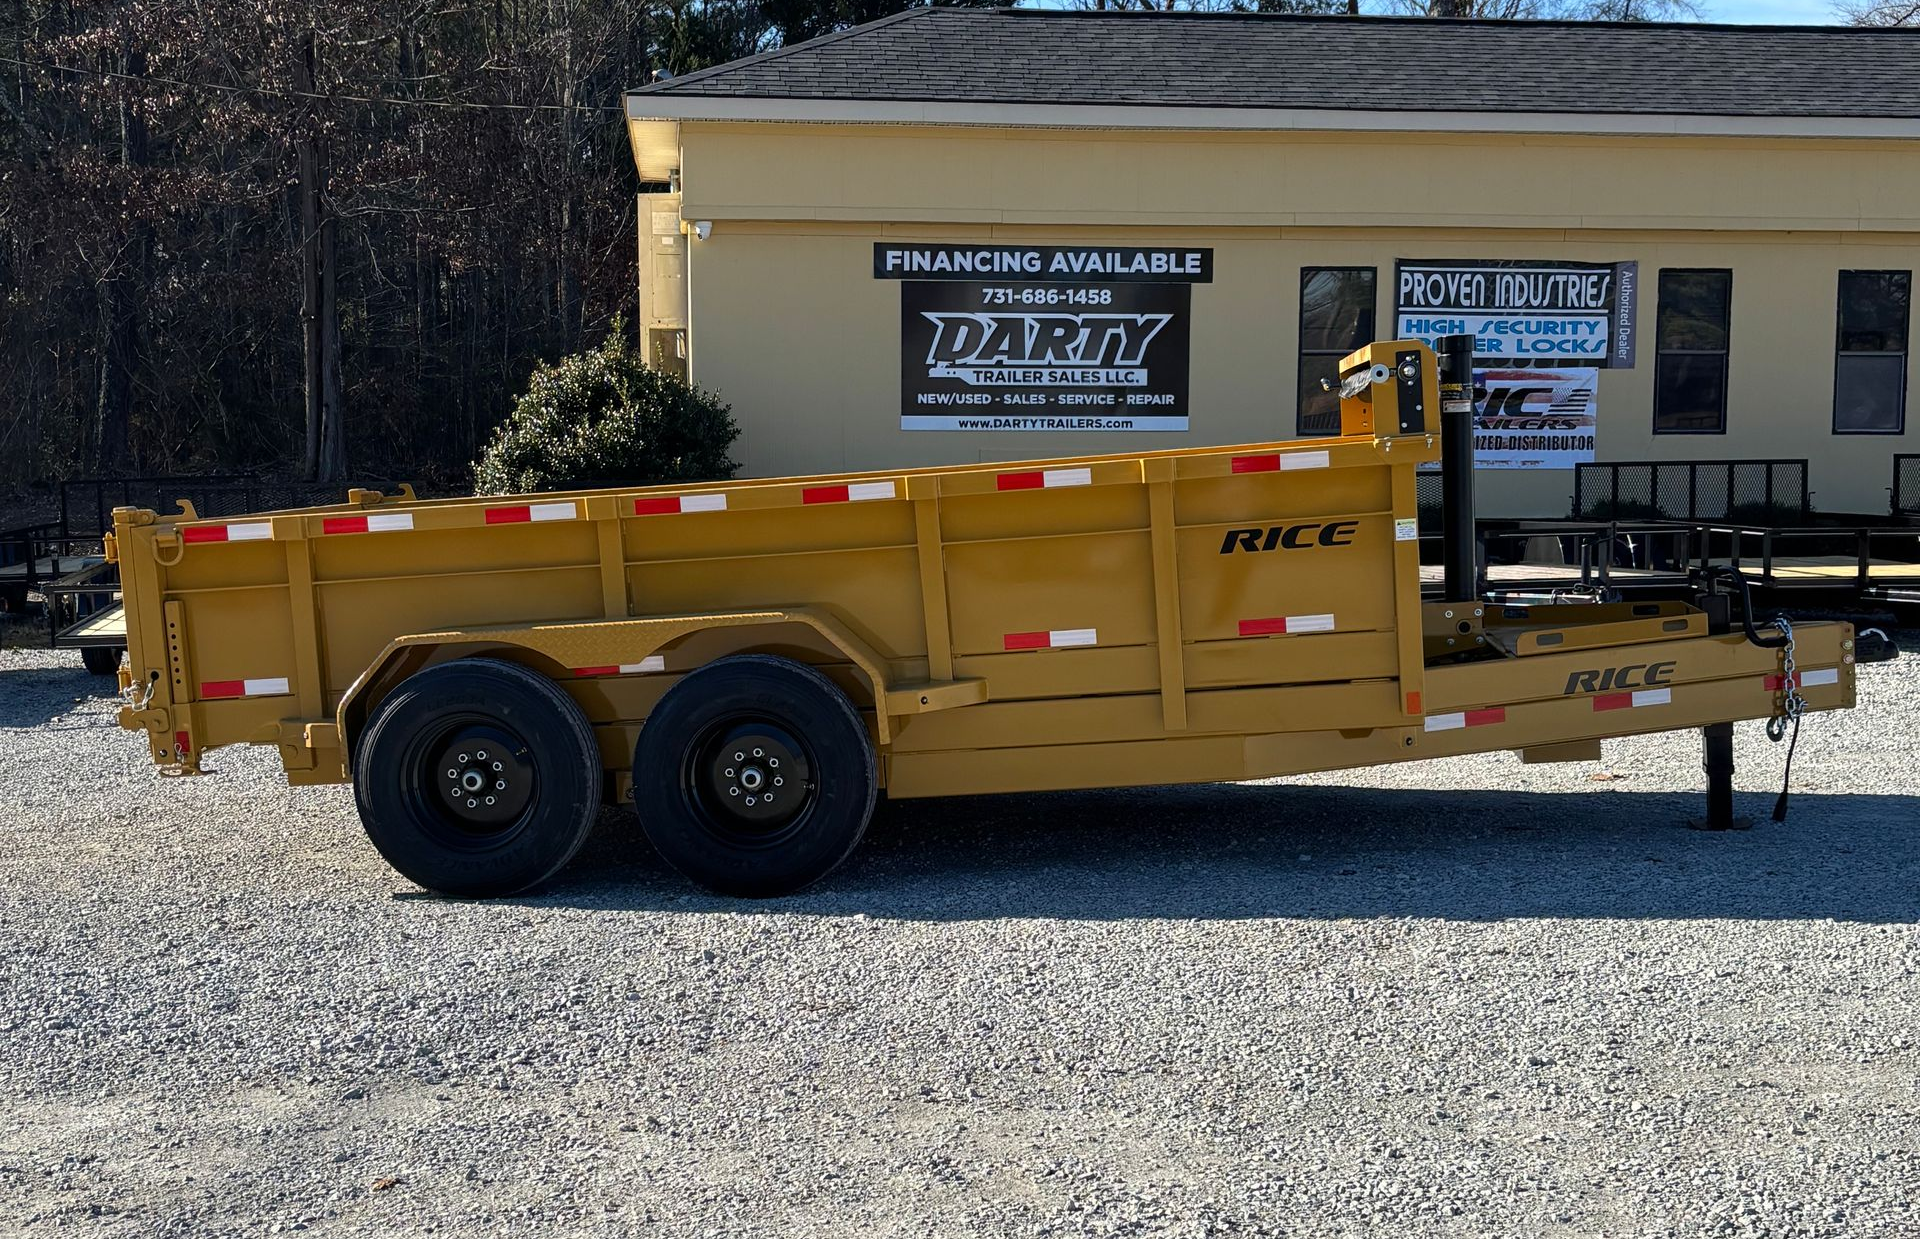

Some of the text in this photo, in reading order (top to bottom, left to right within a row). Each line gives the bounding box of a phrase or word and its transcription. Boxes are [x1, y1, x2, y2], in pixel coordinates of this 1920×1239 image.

[886, 250, 1201, 274] FINANCING AVAILABLE
[982, 288, 1112, 305] 731-686-1458
[1400, 272, 1610, 308] PROVEN INDUSTRIES
[1618, 271, 1633, 360] Authorized Dealer
[1405, 319, 1600, 335] HIGH SECURITY
[920, 311, 1174, 366] DARTY
[1517, 338, 1606, 353] LOCKS
[972, 370, 1140, 383] TRAILER SALES LLC.
[917, 392, 1175, 406] NEW/USED SALES SERVICE REPAIR
[958, 418, 1133, 429] www.DARTYTRAILERS.com
[1508, 435, 1594, 451] DISTRIBUTOR
[1219, 521, 1359, 554] RICE
[1563, 661, 1677, 695] RICE
